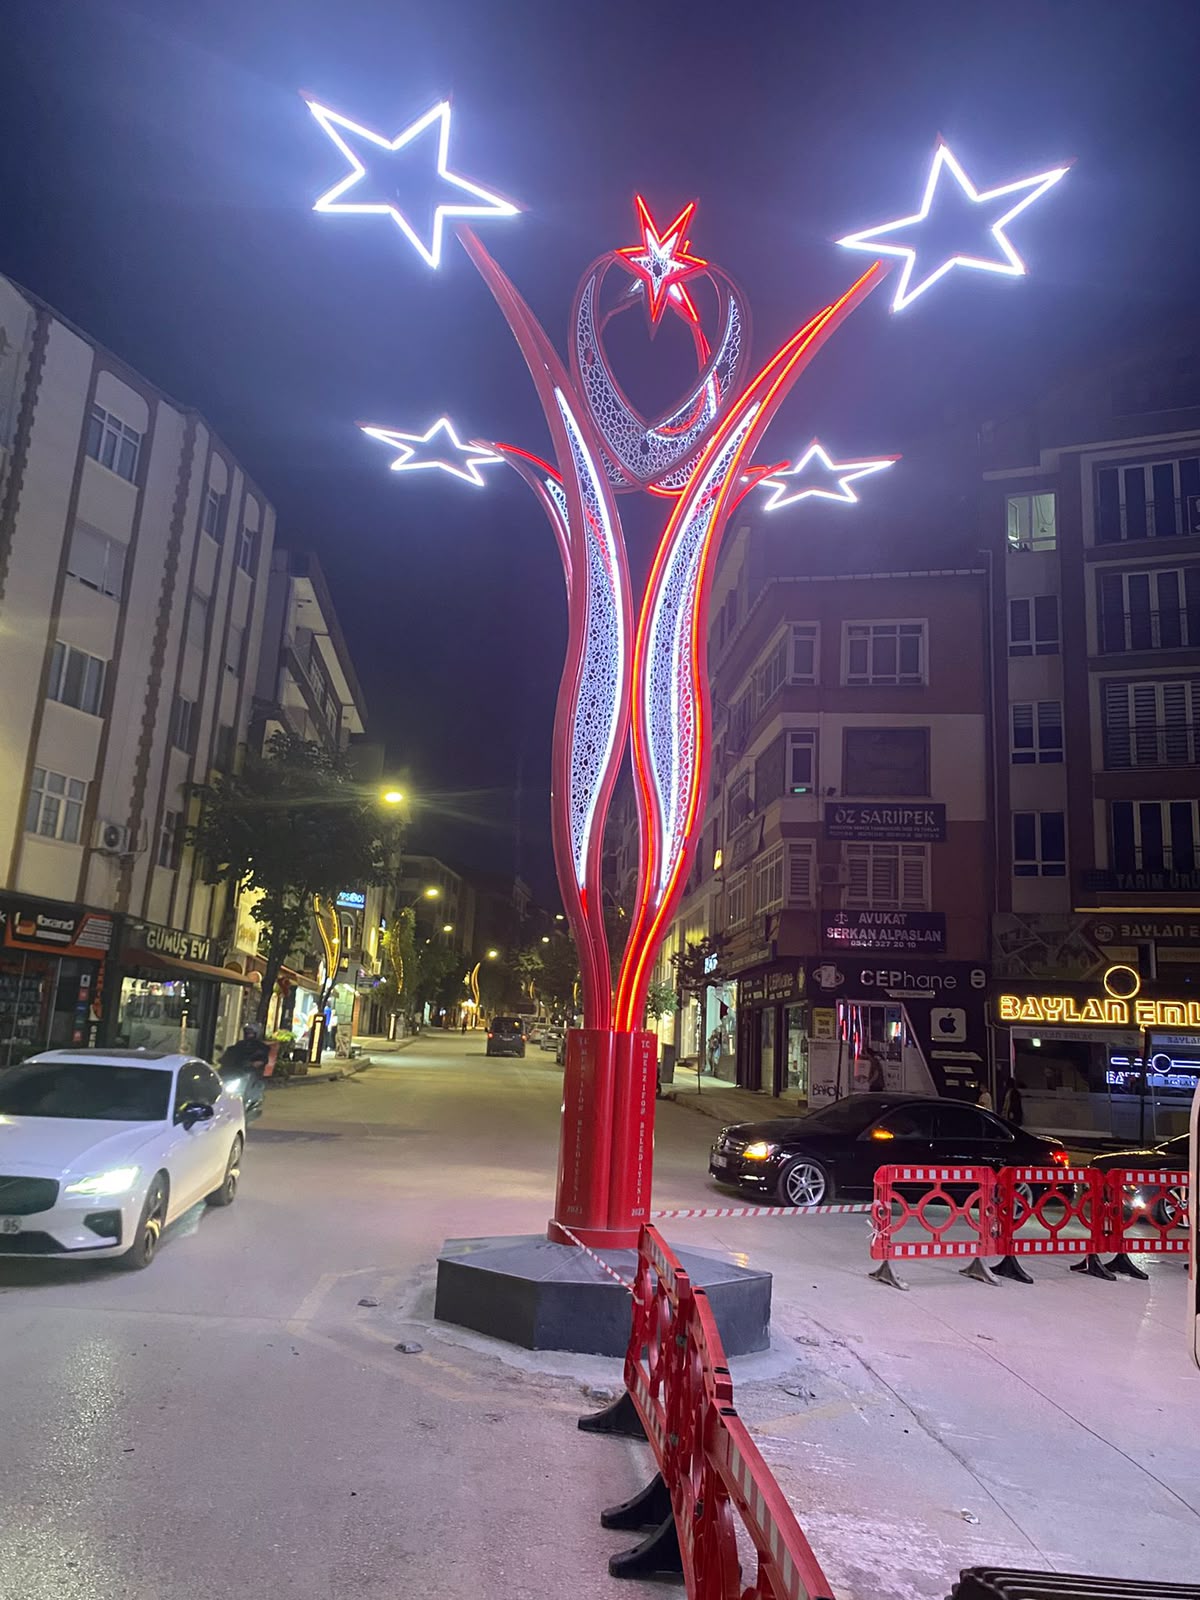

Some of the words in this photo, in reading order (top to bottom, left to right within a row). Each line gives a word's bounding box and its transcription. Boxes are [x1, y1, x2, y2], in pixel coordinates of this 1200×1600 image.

[858, 912, 907, 925] AVUKAT
[826, 927, 877, 941] SERKAN
[879, 929, 942, 943] ALPASLAN
[1120, 924, 1184, 937] BAYLAN
[146, 927, 189, 960] GÜMÜŞ
[190, 938, 211, 961] EVİ
[860, 970, 957, 989] CEPhane
[1000, 995, 1129, 1024] BAYLAN
